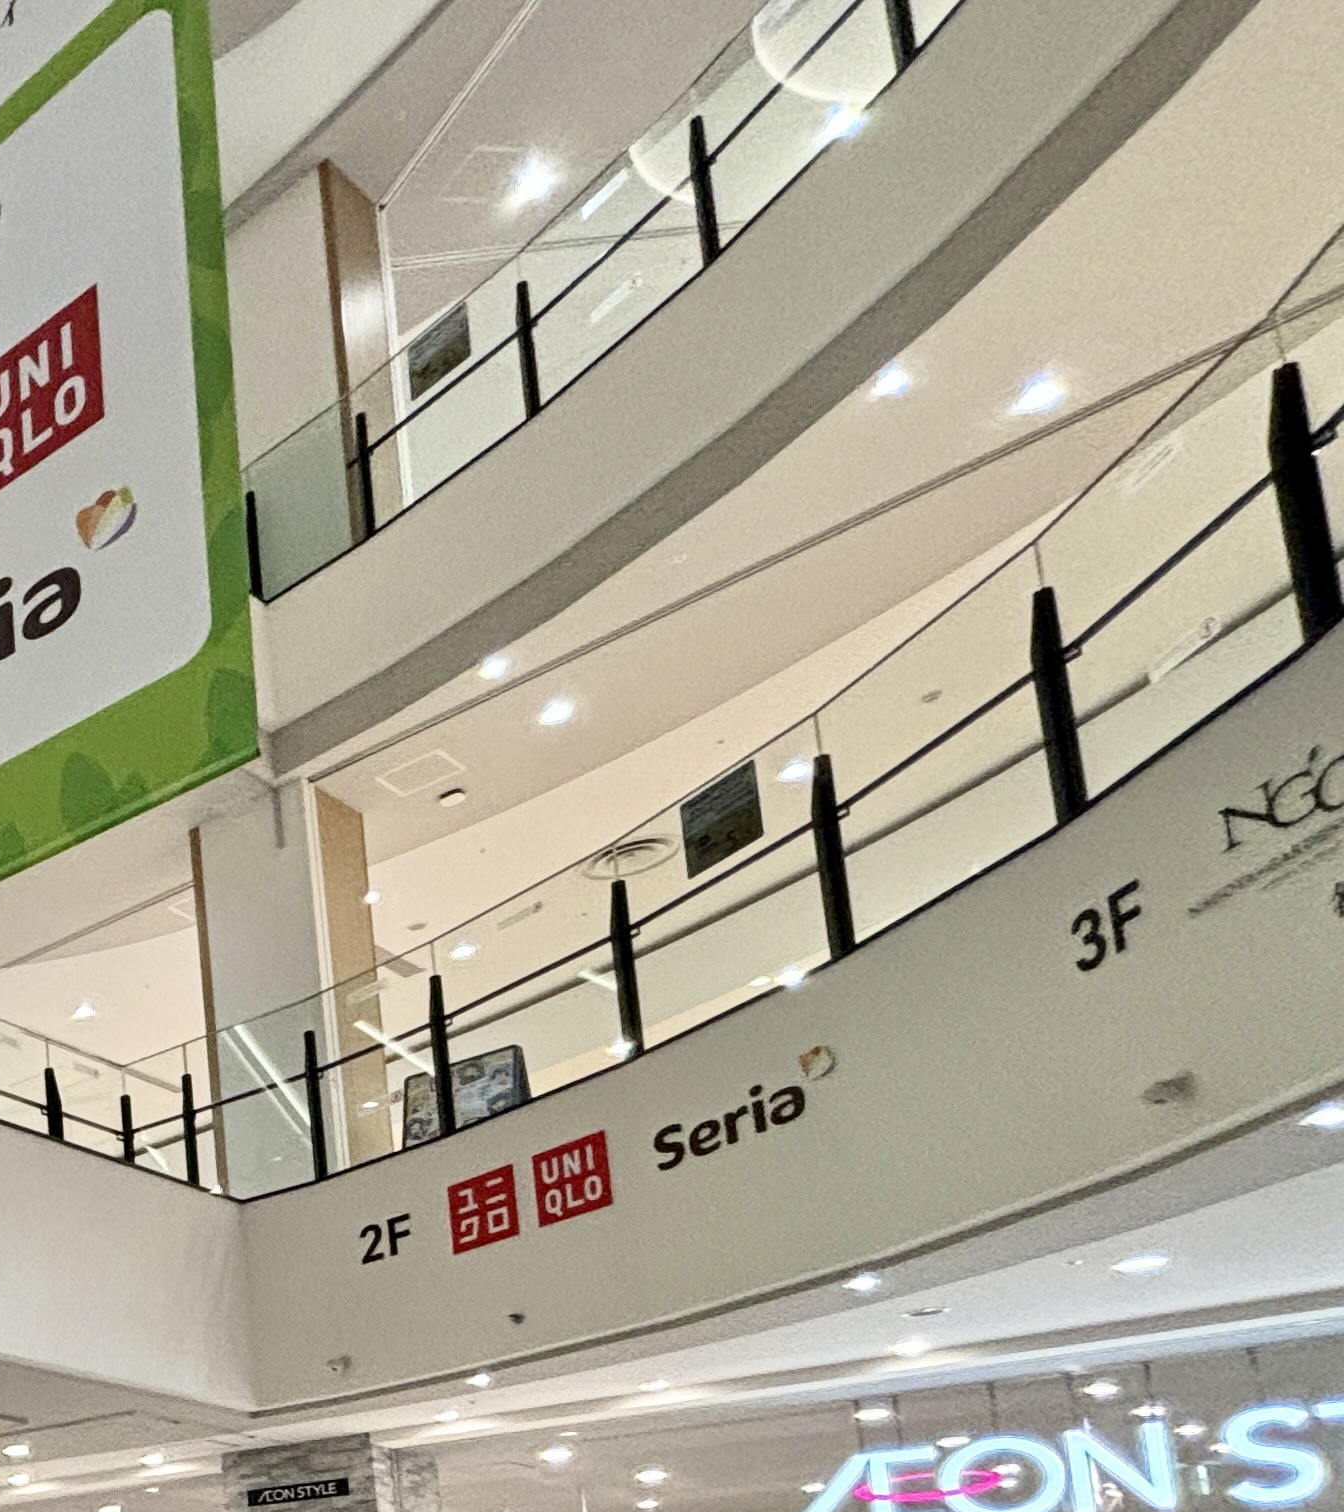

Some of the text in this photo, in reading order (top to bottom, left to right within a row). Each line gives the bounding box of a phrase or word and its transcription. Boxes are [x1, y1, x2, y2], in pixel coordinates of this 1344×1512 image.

[1071, 879, 1142, 972] 3F
[653, 1085, 807, 1172] Seria
[541, 1151, 596, 1186] UNI
[544, 1175, 604, 1217] QLO
[359, 1213, 412, 1266] 2F
[297, 1482, 338, 1499] STYLE
